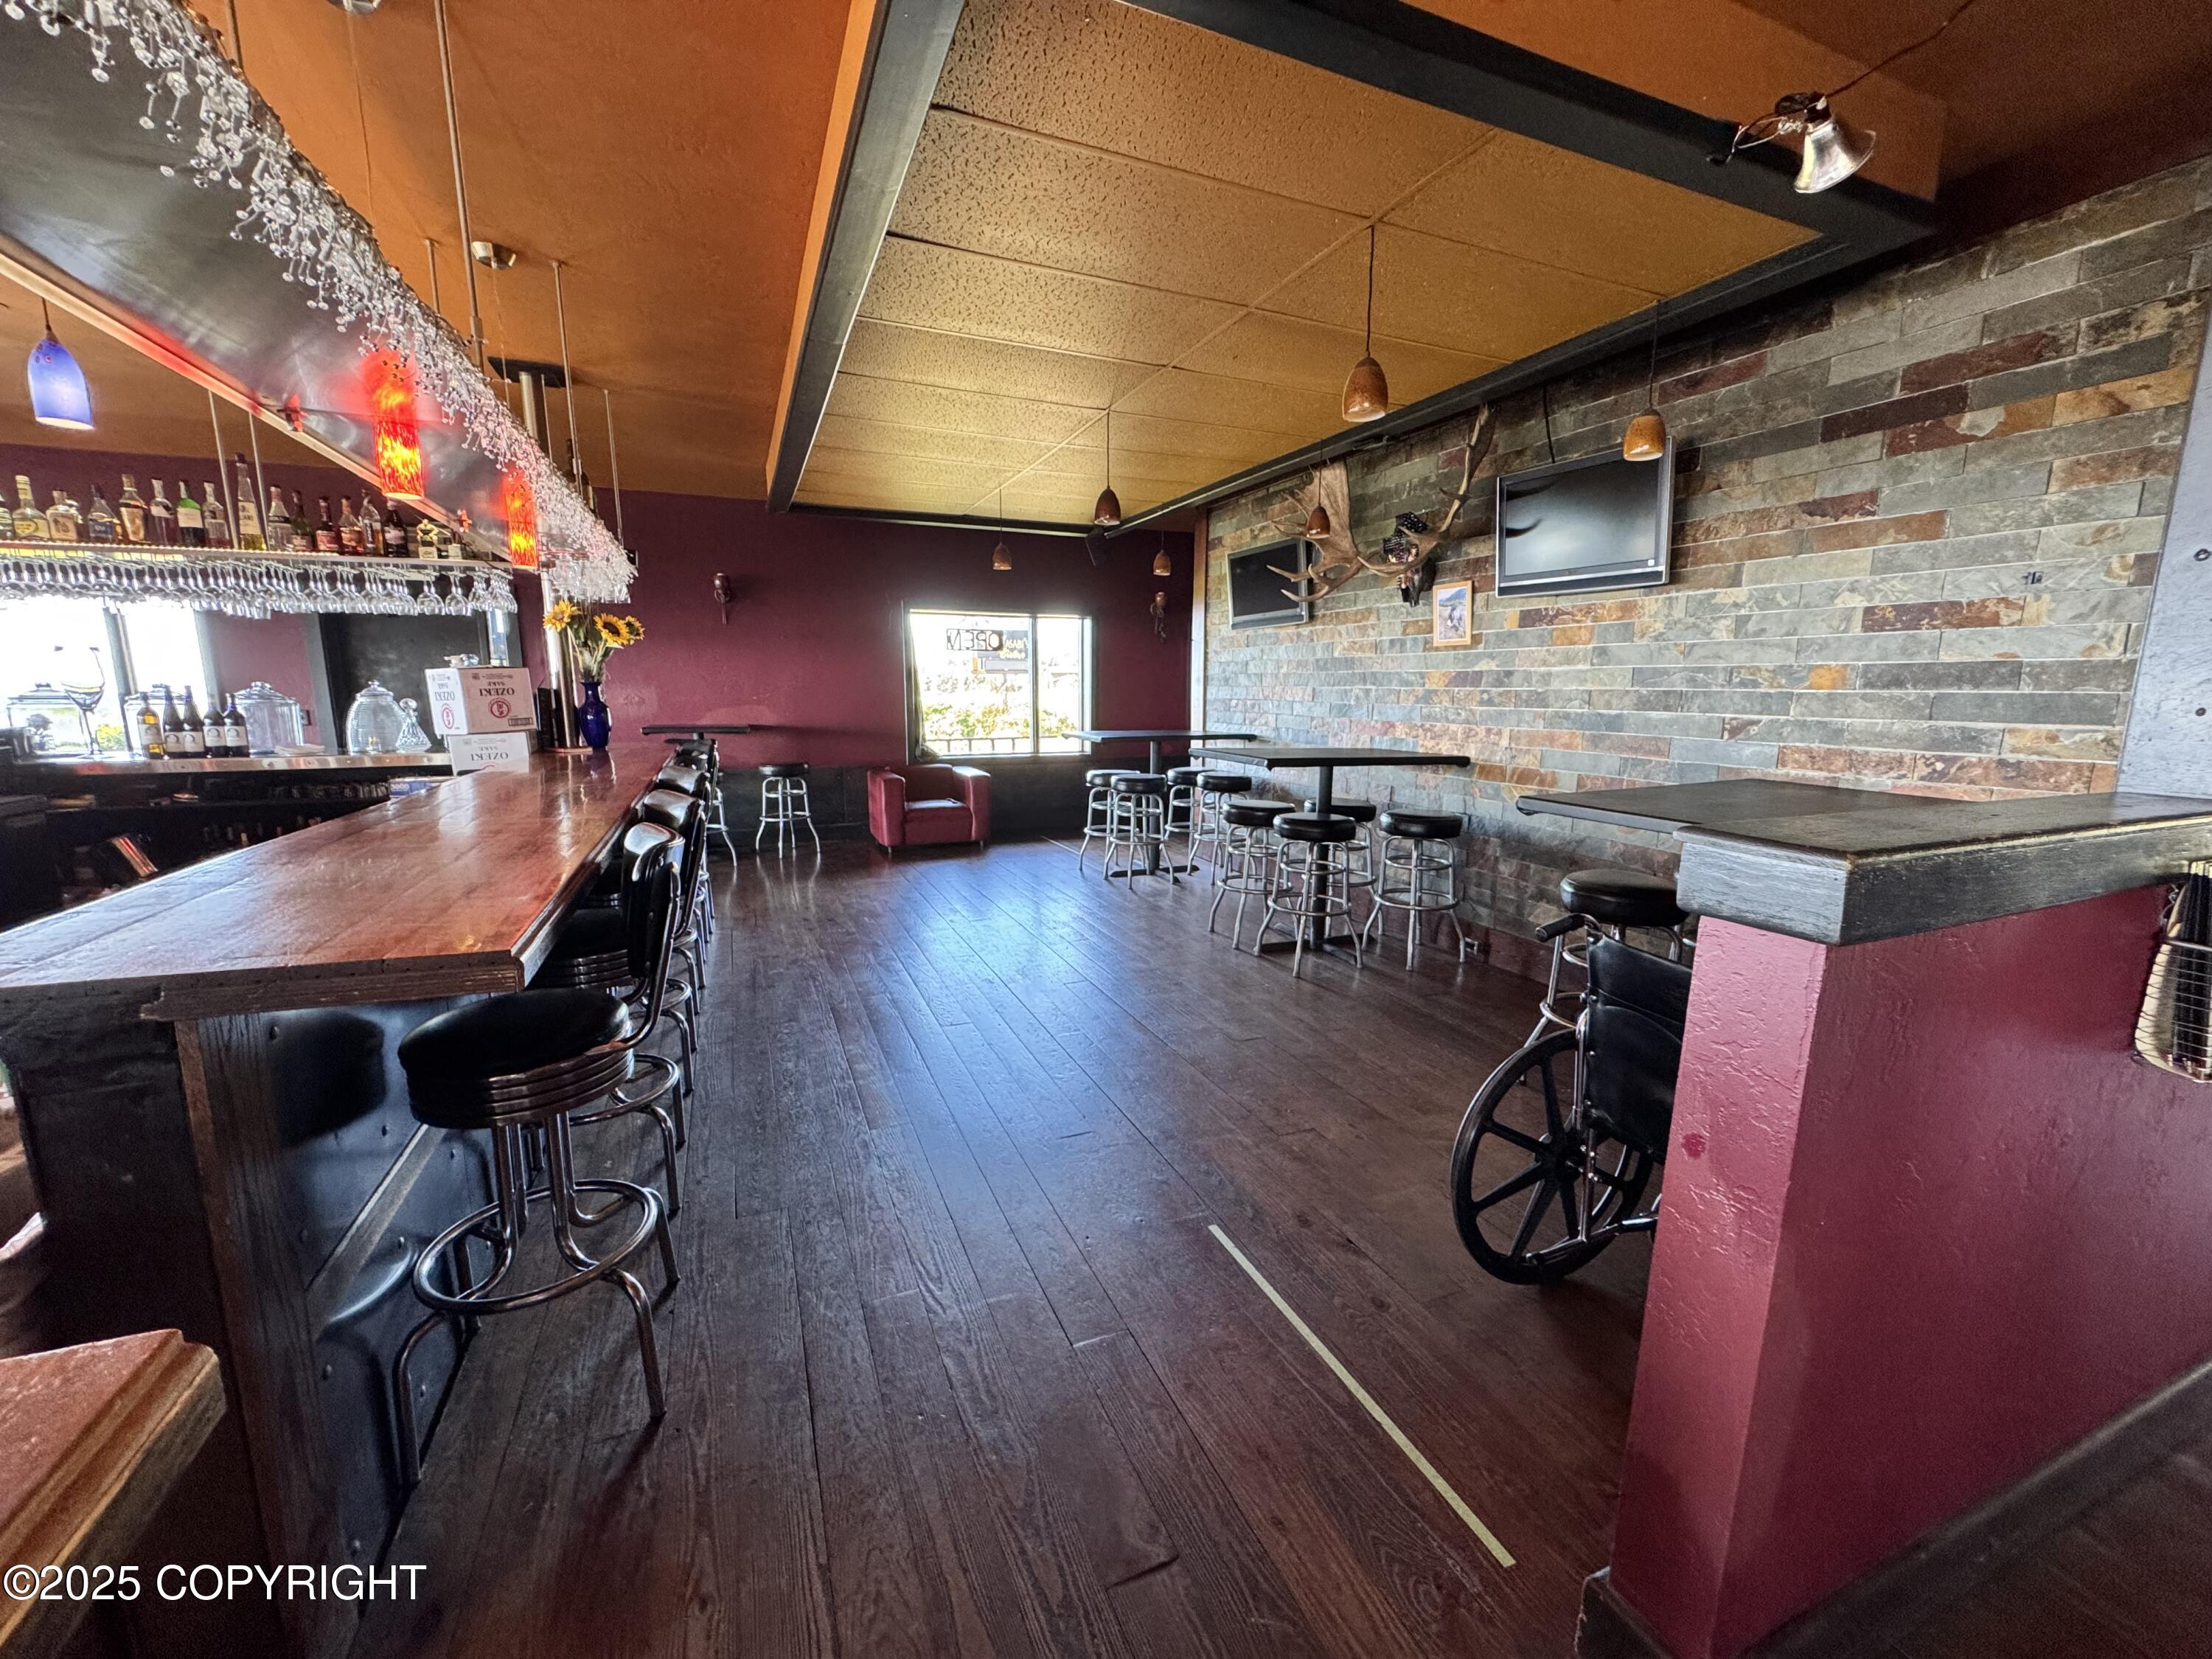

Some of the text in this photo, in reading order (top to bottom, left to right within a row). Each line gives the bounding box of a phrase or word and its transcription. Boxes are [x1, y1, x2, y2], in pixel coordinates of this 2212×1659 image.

[434, 691, 455, 701] OZEKI
[479, 688, 515, 697] OZEKI
[471, 753, 508, 761] OZEKI
